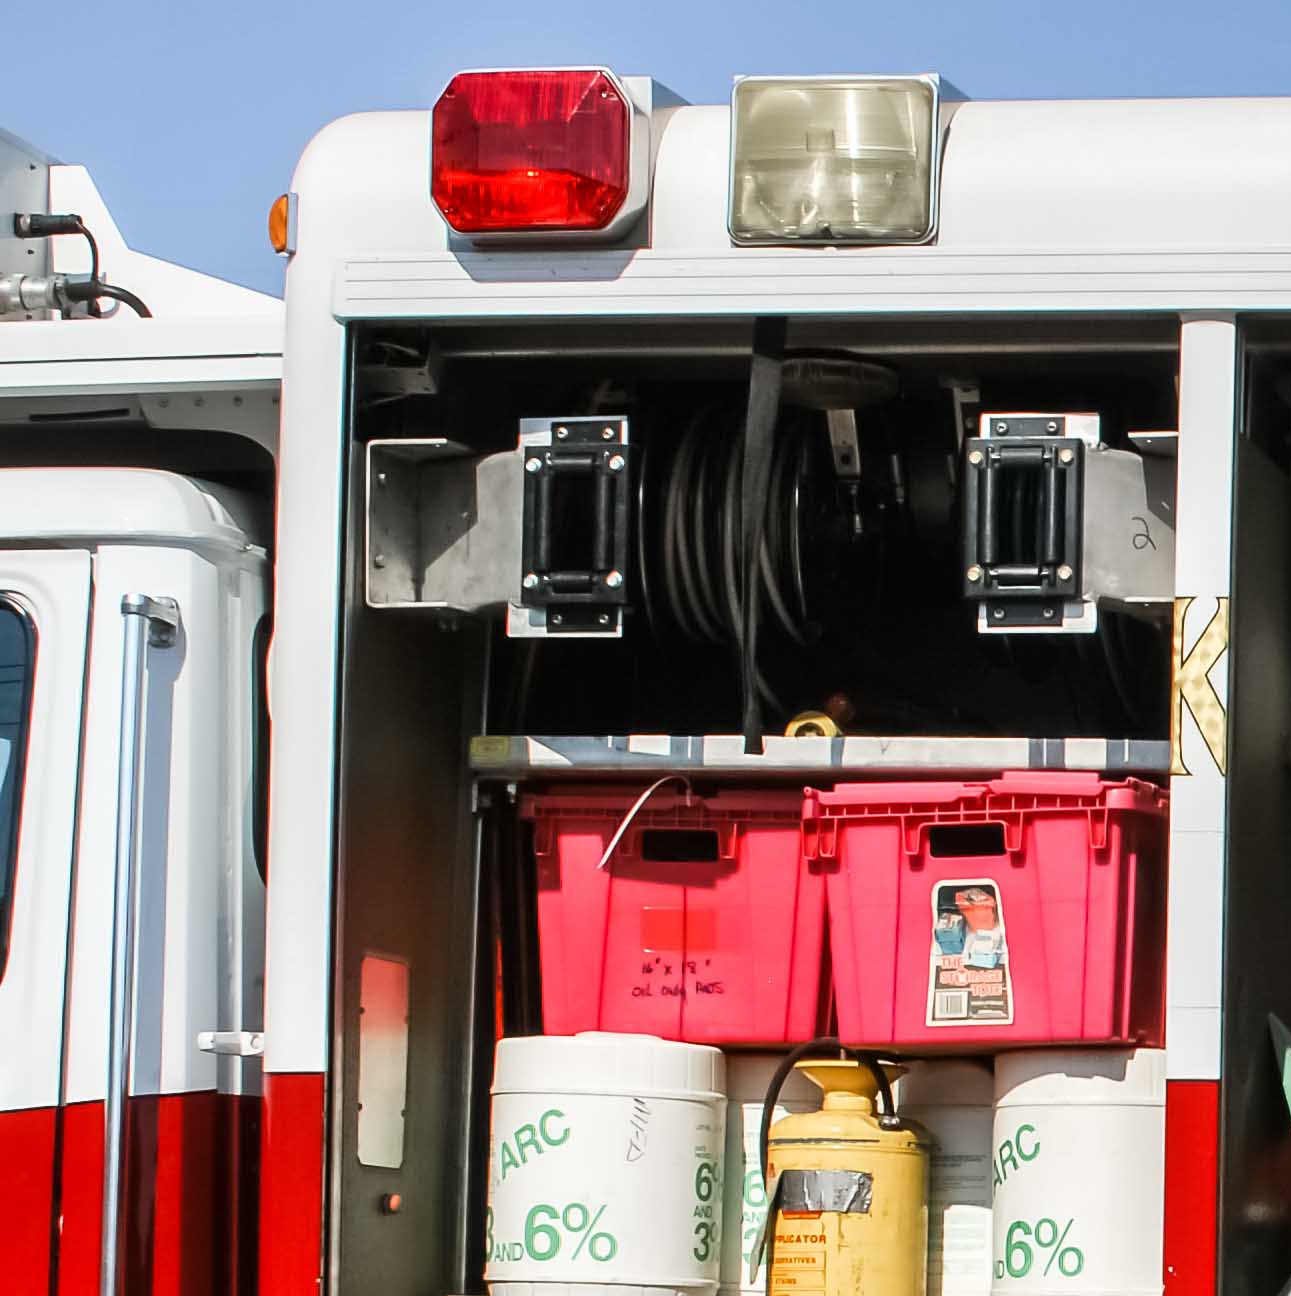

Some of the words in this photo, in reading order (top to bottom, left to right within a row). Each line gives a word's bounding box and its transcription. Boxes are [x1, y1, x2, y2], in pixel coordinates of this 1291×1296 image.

[1131, 516, 1157, 551] 2
[499, 1108, 571, 1181] ARC
[494, 1242, 525, 1263] AND
[524, 1202, 617, 1262] 6%
[1005, 1217, 1085, 1279] 6%
